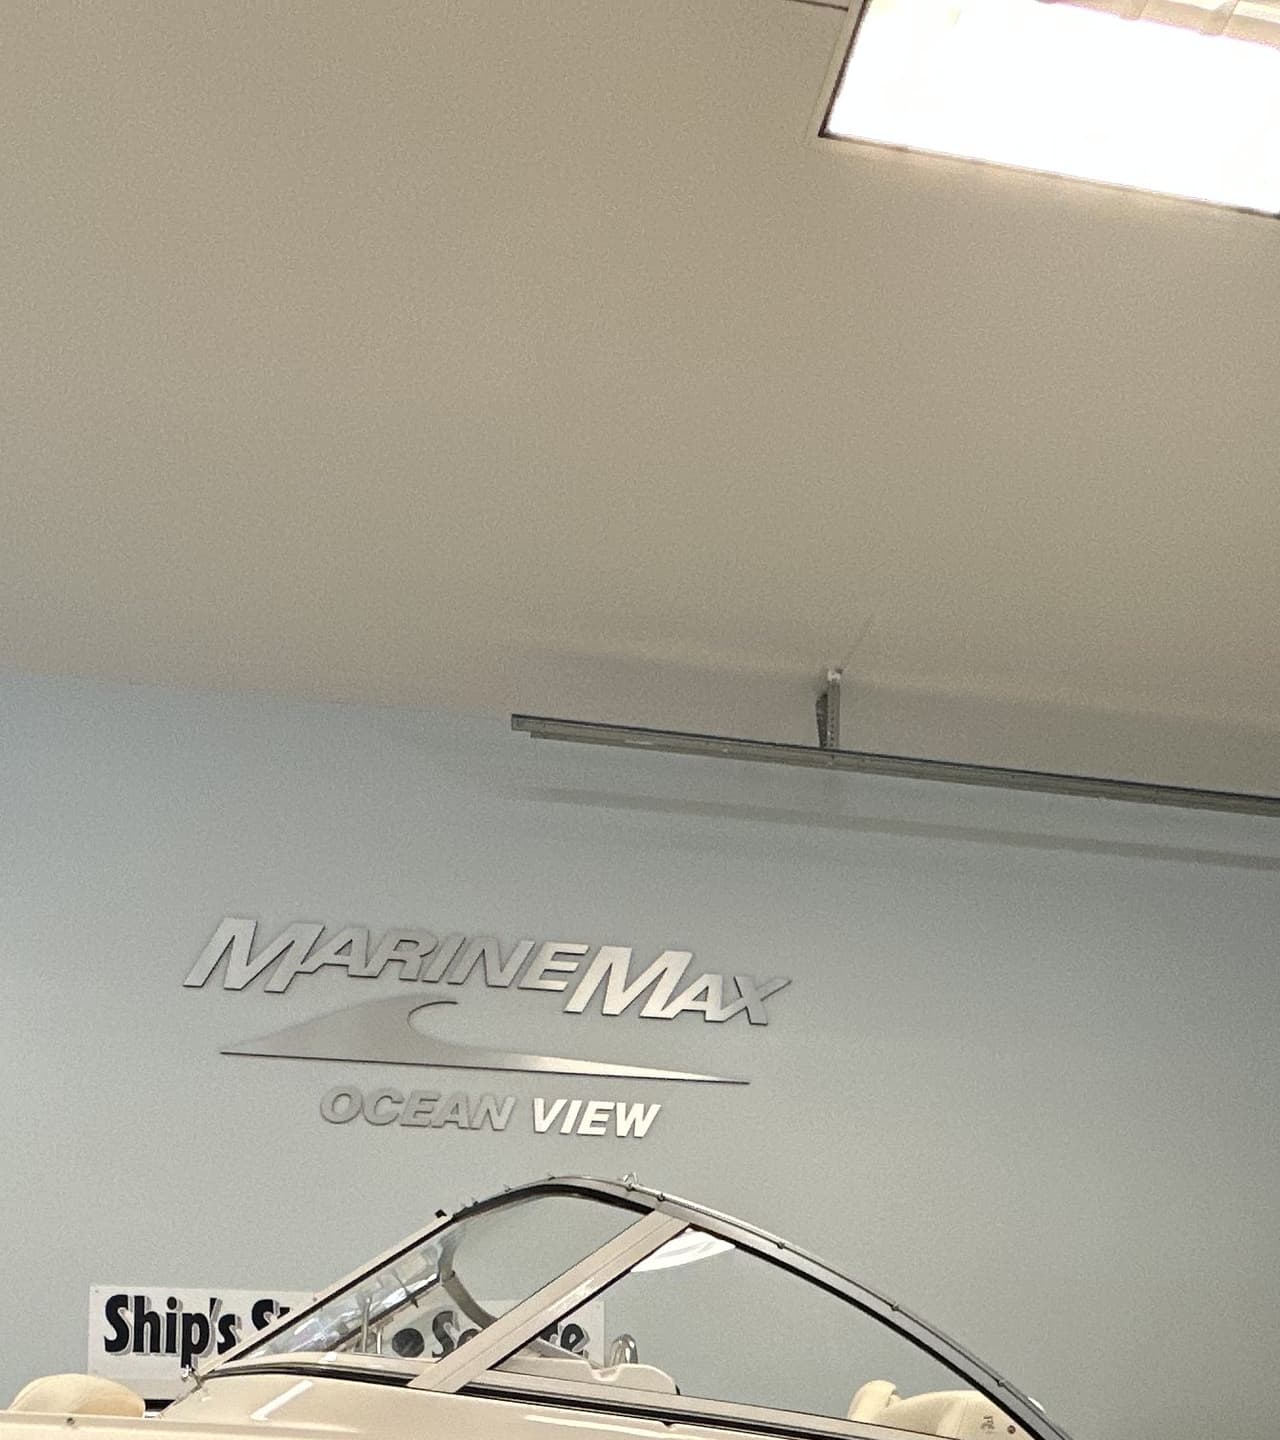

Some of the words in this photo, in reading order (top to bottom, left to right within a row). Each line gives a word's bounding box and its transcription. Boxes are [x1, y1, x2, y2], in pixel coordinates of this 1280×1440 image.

[320, 1086, 515, 1131] OCEAN
[532, 1097, 661, 1138] VIEW
[104, 1294, 242, 1370] Ship's
